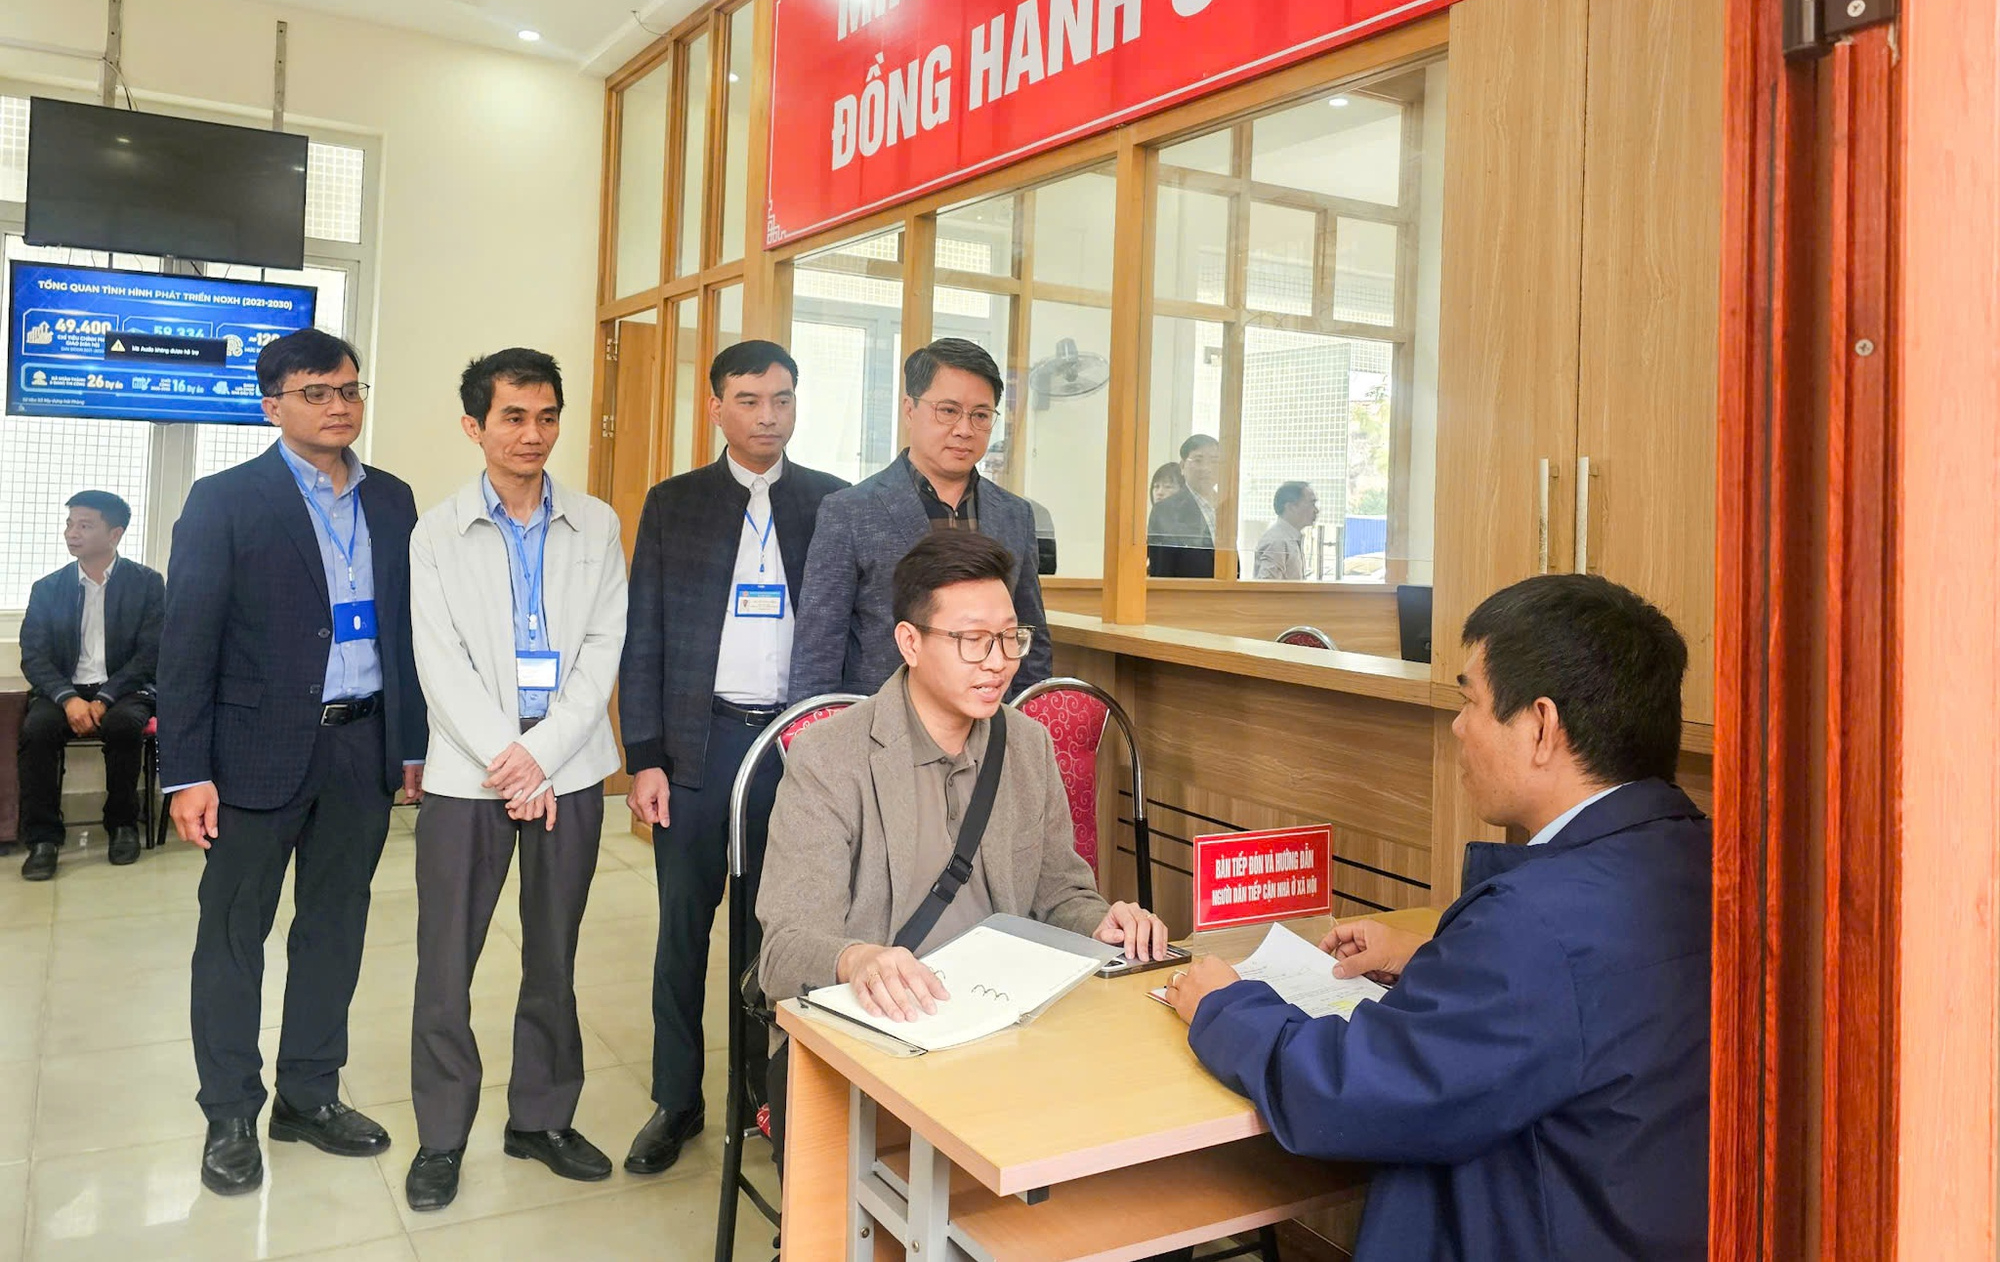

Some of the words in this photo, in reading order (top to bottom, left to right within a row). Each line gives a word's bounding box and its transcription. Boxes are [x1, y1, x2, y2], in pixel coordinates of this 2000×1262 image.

[831, 45, 952, 171] ĐỒNG
[70, 282, 100, 293] QUAN
[102, 284, 126, 295] TÌNH
[128, 287, 153, 298] HÌNH
[155, 289, 181, 300] PHÁT
[213, 295, 241, 305] NOXH
[242, 297, 293, 310] (2021-2030)
[87, 374, 104, 388] 26
[172, 379, 186, 392] 16
[1215, 854, 1231, 879] BÀN
[1232, 850, 1248, 877] TIẾP
[1248, 851, 1264, 875] ĐÓN
[1264, 849, 1274, 873] VÀ
[1275, 847, 1299, 873] HƯỚNG
[1299, 842, 1314, 870] DẪN
[1211, 884, 1232, 907] NGƯỜI
[1233, 883, 1247, 904] DÂN
[1247, 879, 1262, 902] TIẾP
[1262, 879, 1276, 903] CẬN
[1276, 877, 1291, 898] NHÀ
[1290, 875, 1297, 896] Ở
[1296, 876, 1306, 896] XÃ
